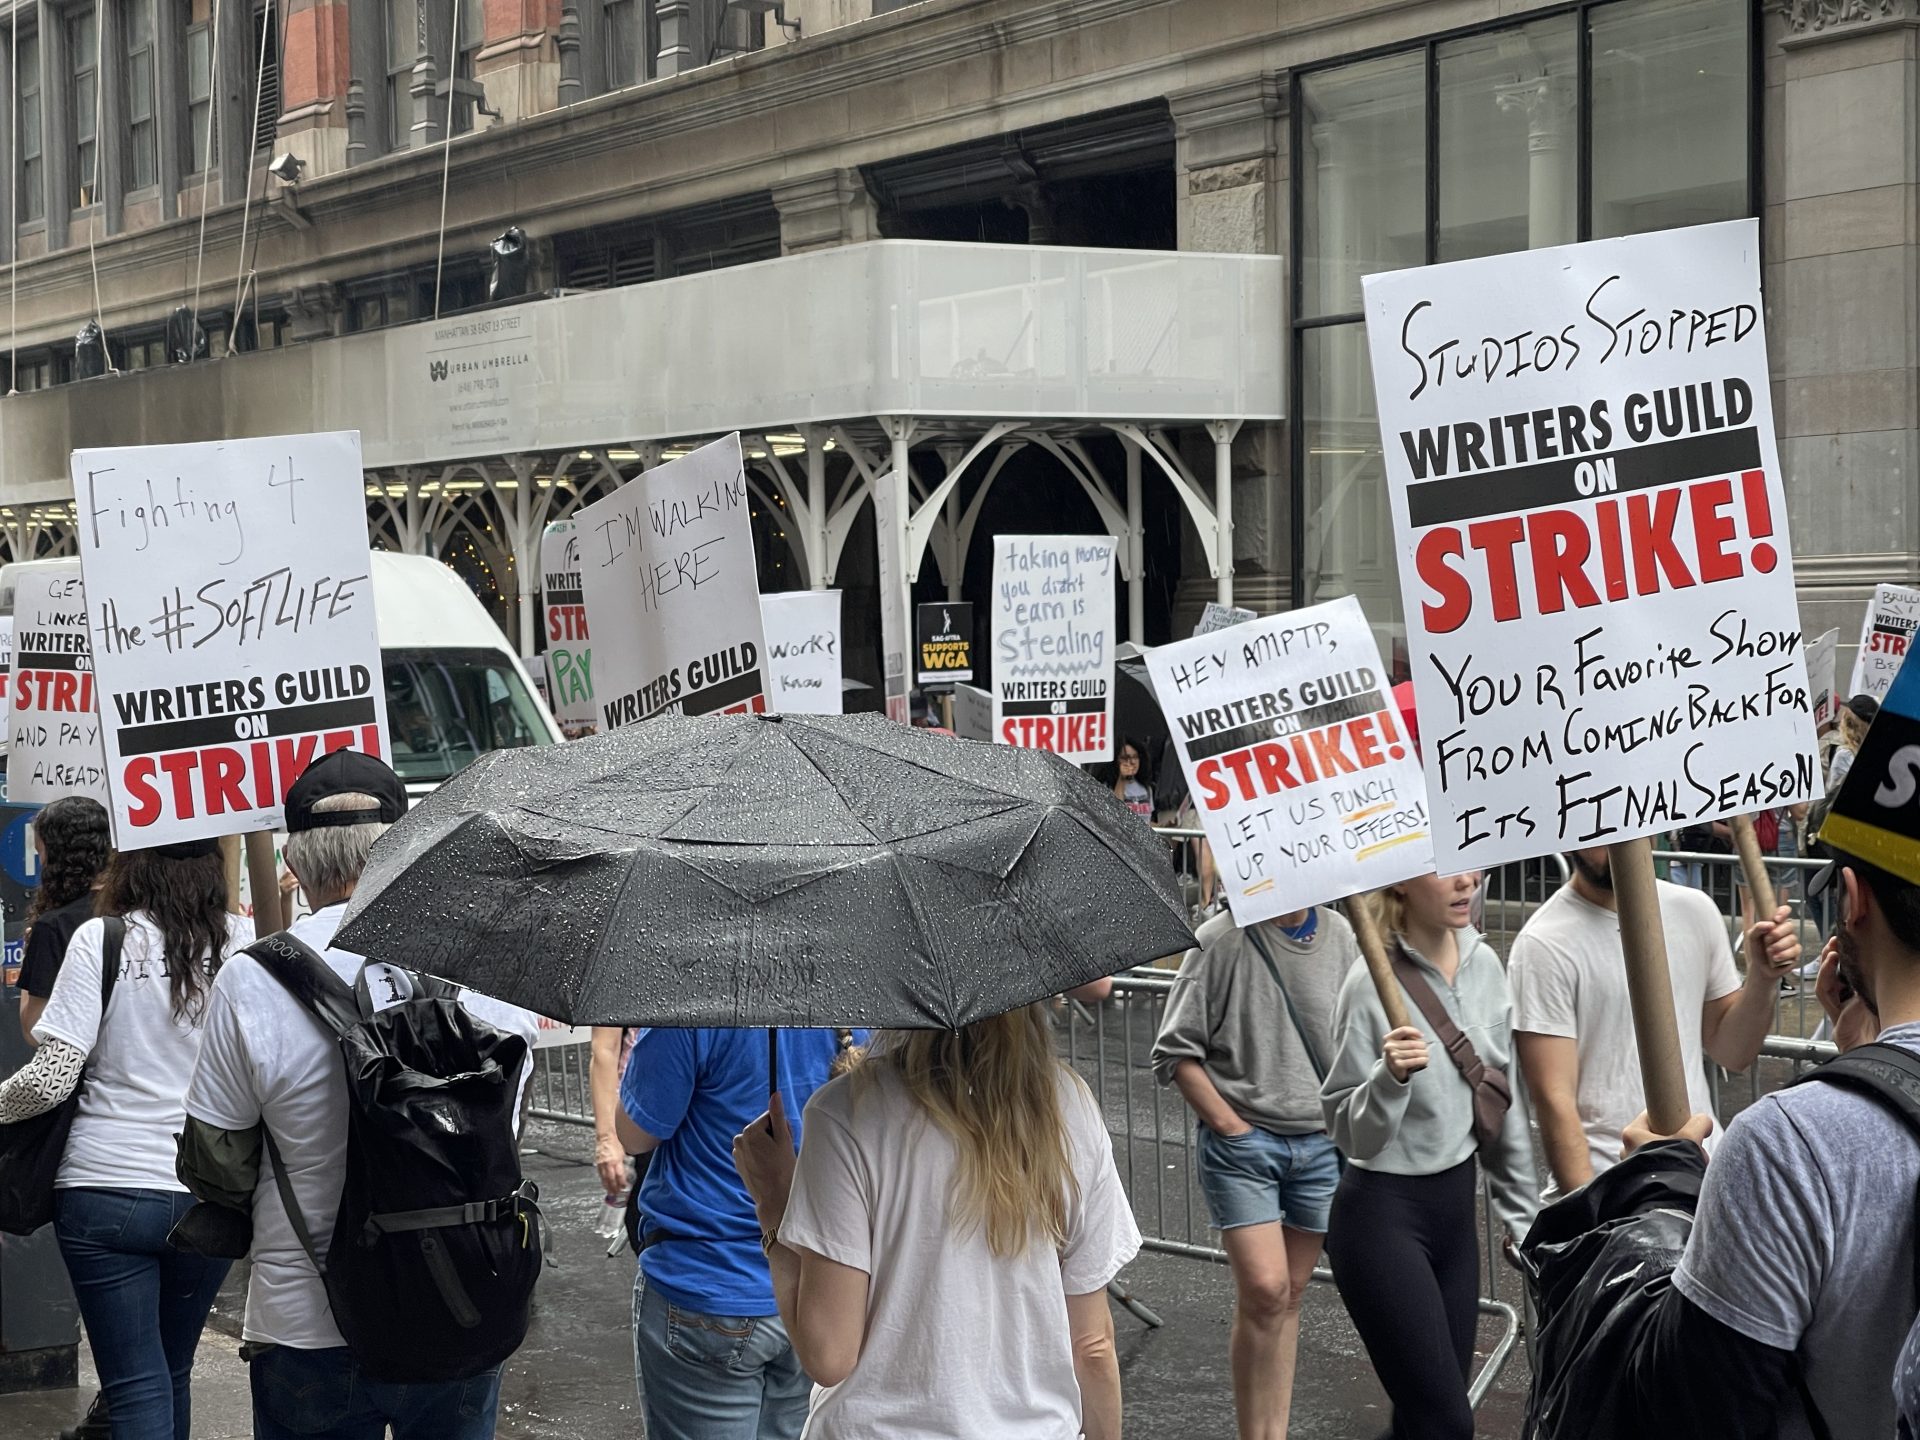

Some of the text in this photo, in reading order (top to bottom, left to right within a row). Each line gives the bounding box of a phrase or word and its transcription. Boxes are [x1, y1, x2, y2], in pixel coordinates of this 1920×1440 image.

[1586, 275, 1758, 364] STOPPED
[450, 354, 529, 375] URBAN UMBRELLA
[1399, 377, 1754, 480] WRITERS GUILD
[1574, 457, 1618, 496] ON
[88, 456, 304, 565] Fighting 4
[595, 506, 642, 567] I'M
[639, 537, 725, 612] HERE
[1005, 541, 1071, 579] taking
[1415, 469, 1778, 634] STRIKE!
[1001, 580, 1031, 612] you
[1015, 600, 1065, 625] earn
[1875, 613, 1918, 630] WRITERS
[95, 597, 146, 653] the
[922, 642, 969, 653] SUPPORTS
[997, 620, 1104, 669] Stealing
[1870, 632, 1911, 656] STR
[552, 648, 594, 707] PAY
[603, 668, 682, 731] WRITERS
[687, 641, 758, 690] GUILD
[922, 651, 969, 669] WGA
[1170, 622, 1338, 694] HEY AMPTP,
[1573, 627, 1703, 697] Favorite
[1873, 657, 1901, 671] BE
[15, 670, 98, 713] STRI
[113, 664, 371, 726] WRITERS GUILD
[1002, 678, 1107, 700] WRITERS GUILD
[1051, 701, 1067, 714] ON
[1177, 667, 1377, 740] WRITERS GUILD
[15, 723, 98, 748] AND PAY
[234, 714, 269, 740] ON
[1002, 713, 1107, 754] STRIKE!
[1272, 714, 1300, 736] ON
[1436, 728, 1553, 793] FROM
[1563, 707, 1684, 755] COMING
[1687, 684, 1760, 731] BACK
[1765, 662, 1809, 716] FOR
[124, 725, 382, 828] STRIK
[1196, 710, 1406, 811] STRIKE!
[1224, 777, 1399, 849] LET US PUNCH
[1456, 742, 1813, 851] ITS FINAL SEASON
[1235, 801, 1429, 881] UP YOUR OFFERS!
